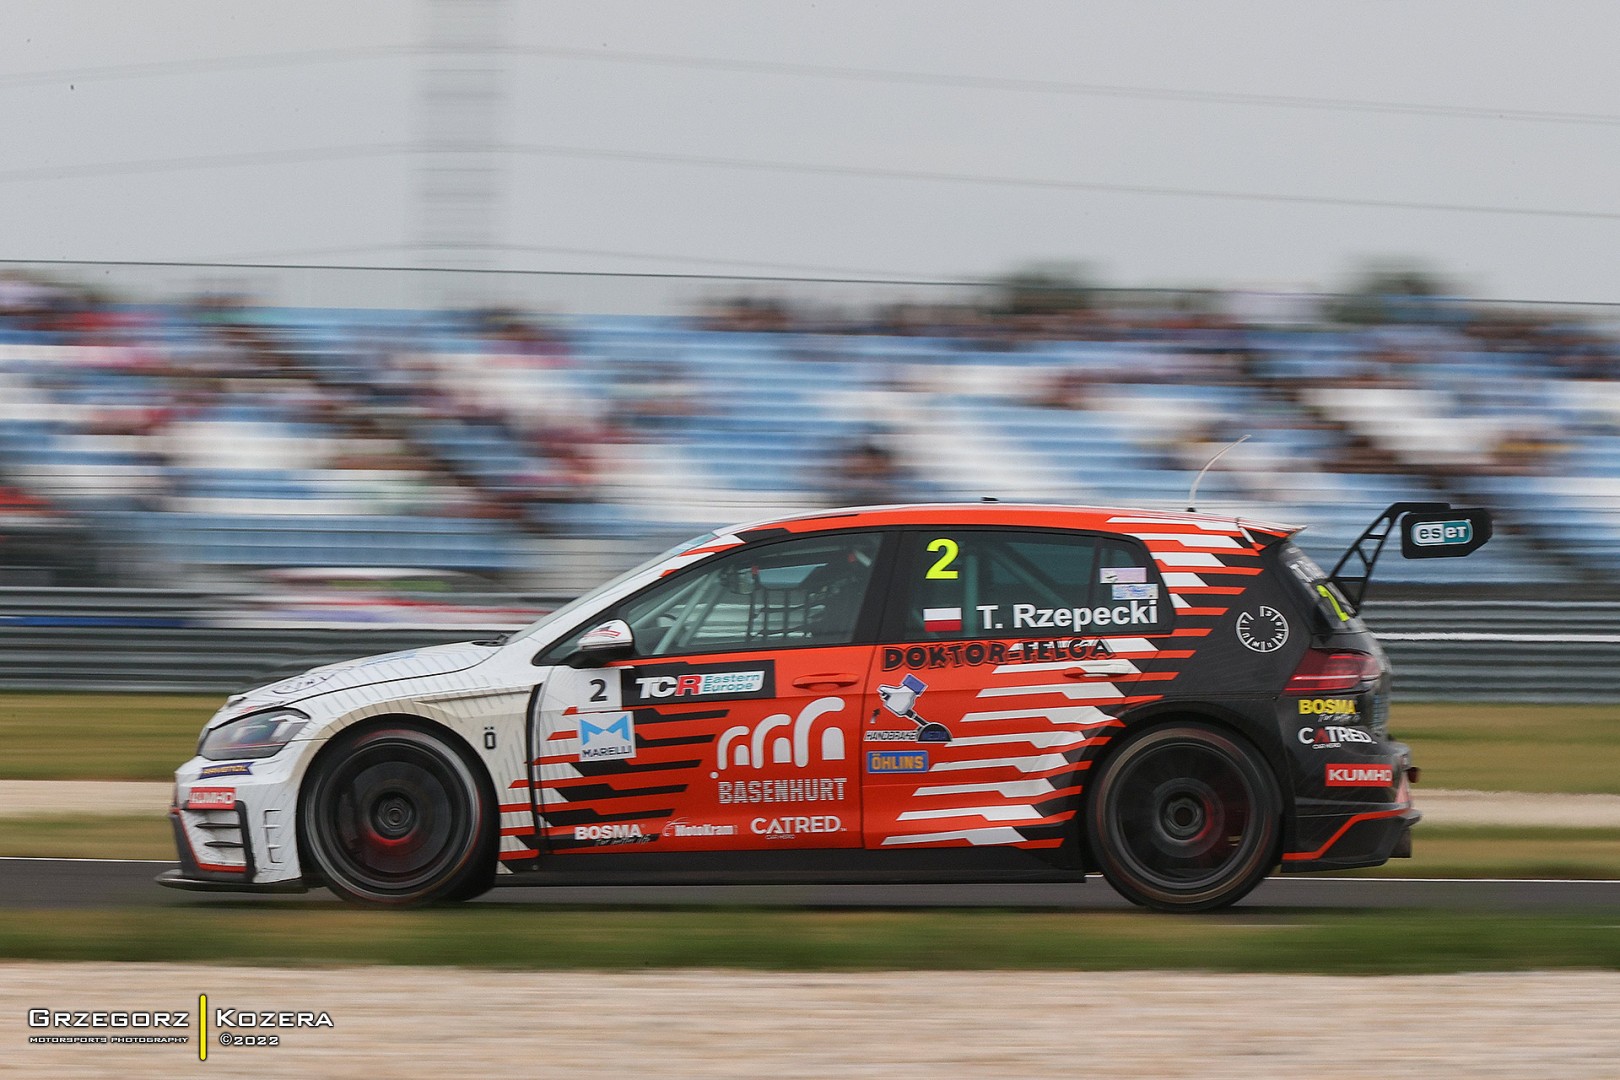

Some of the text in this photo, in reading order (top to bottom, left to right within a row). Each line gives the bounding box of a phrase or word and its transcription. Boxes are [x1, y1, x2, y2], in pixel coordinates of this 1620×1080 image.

[925, 538, 960, 580] 2
[975, 600, 1158, 633] T. Rzepecki
[635, 675, 702, 699] TCR
[703, 673, 761, 684] Eastern
[588, 678, 608, 703] 2
[702, 683, 754, 693] Europe
[1297, 698, 1357, 715] BOSMA
[1297, 726, 1373, 745] CATRED
[582, 745, 634, 758] MARELLI
[871, 753, 925, 771] ÖHLINS
[1327, 768, 1393, 782] KUMHO
[717, 777, 848, 804] BASENHURT
[574, 823, 643, 841] BOSMA
[749, 815, 842, 835] CATRED
